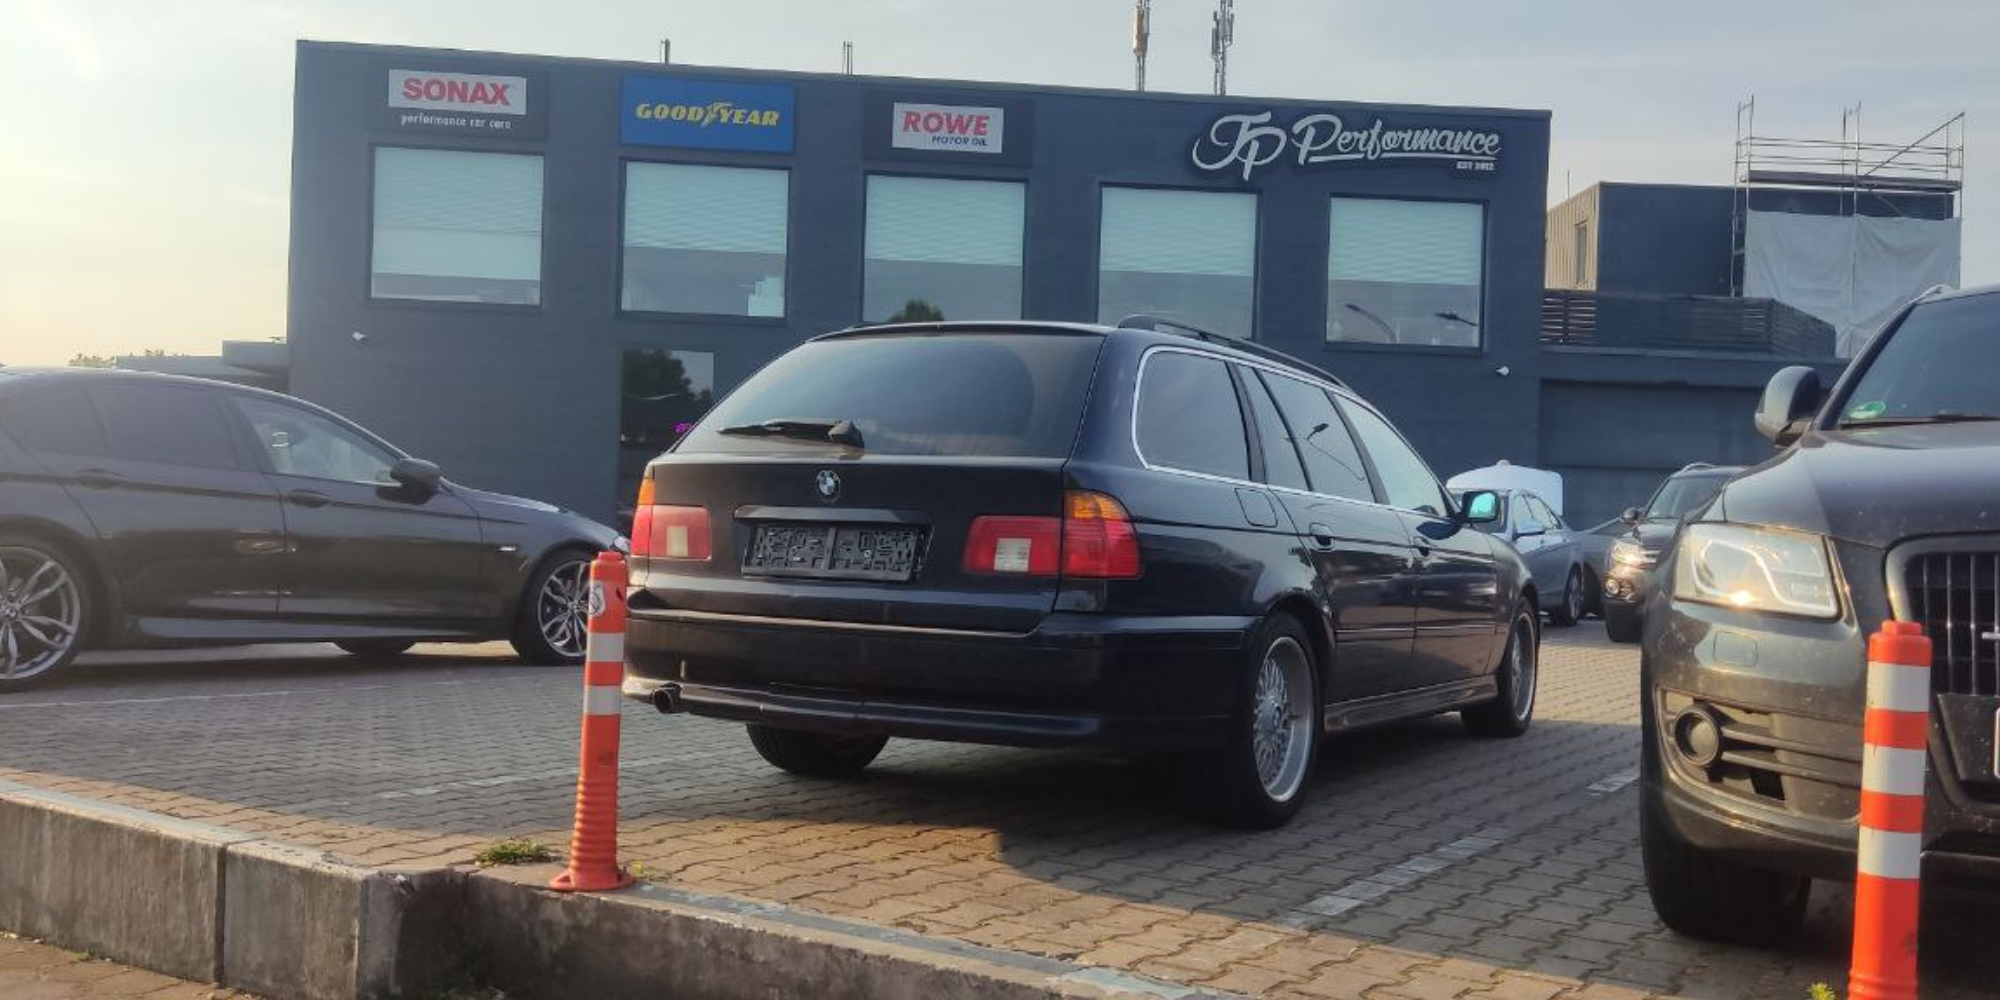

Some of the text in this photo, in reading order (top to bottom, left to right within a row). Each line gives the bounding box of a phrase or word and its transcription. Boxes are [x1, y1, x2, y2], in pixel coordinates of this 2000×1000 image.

[403, 77, 510, 106] SONAX
[401, 113, 511, 129] performance car care
[635, 102, 779, 127] GOODYEAR
[902, 110, 990, 136] ROWE
[931, 136, 988, 147] MOTOR OIL
[1291, 114, 1500, 165] Performance
